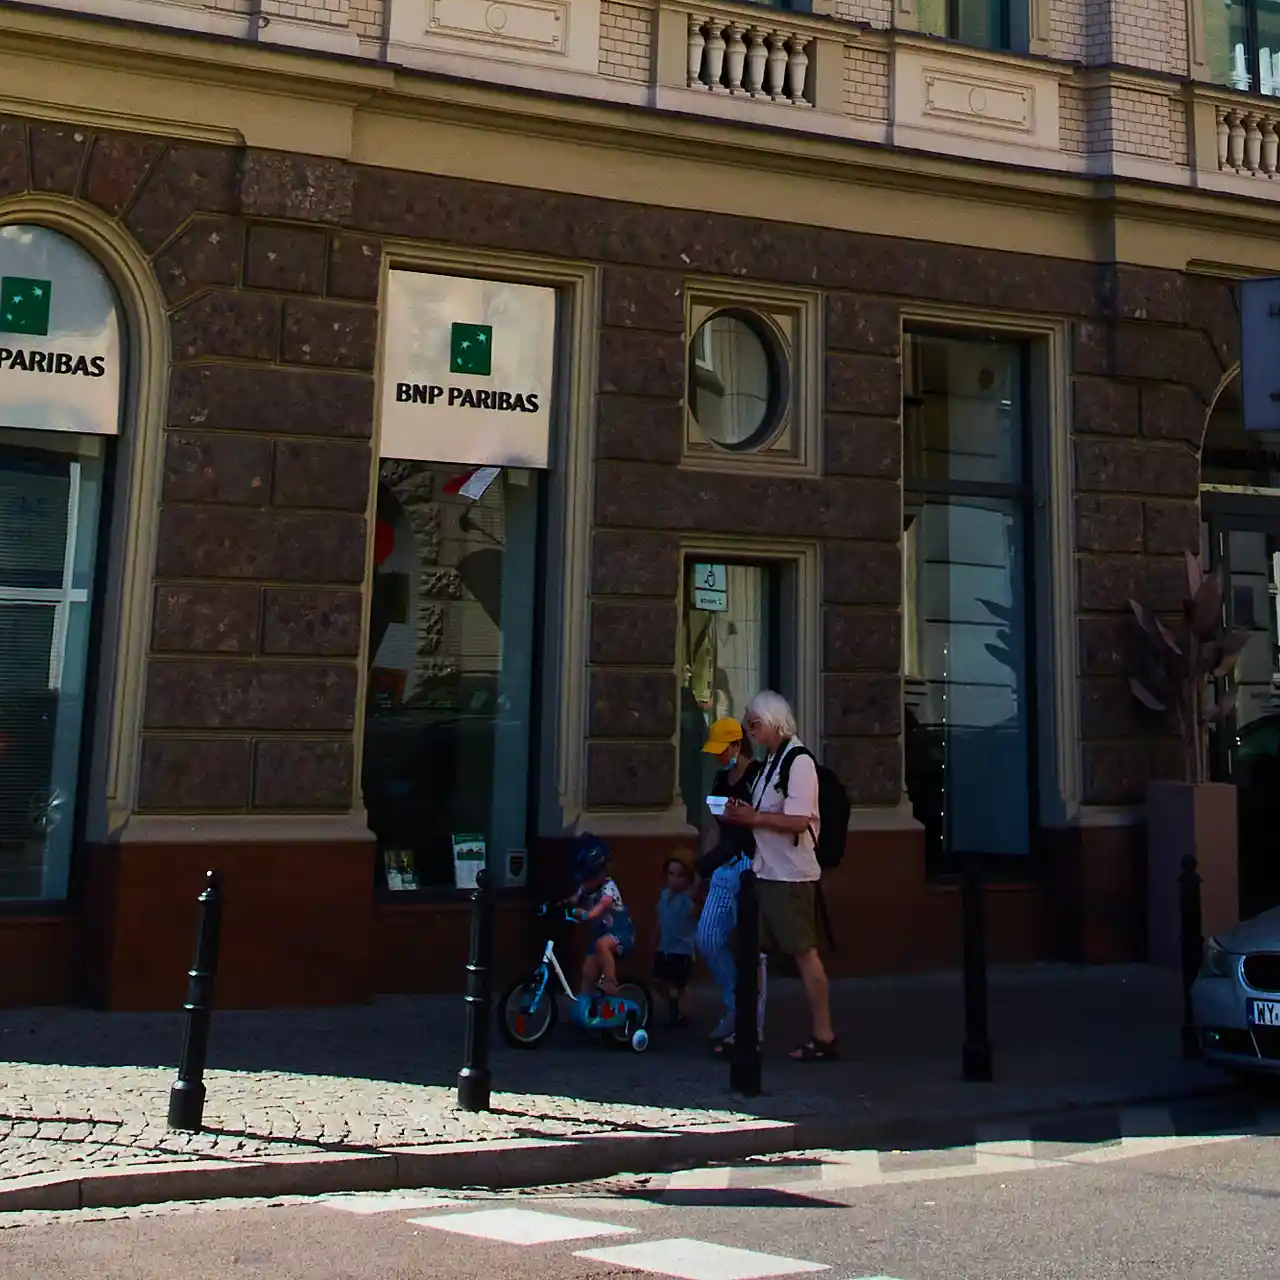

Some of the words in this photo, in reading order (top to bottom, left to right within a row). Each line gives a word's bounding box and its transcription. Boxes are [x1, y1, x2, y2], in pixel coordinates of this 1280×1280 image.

[396, 382, 444, 405] BNP
[448, 387, 539, 413] PARIBAS
[1256, 1002, 1275, 1025] WY
